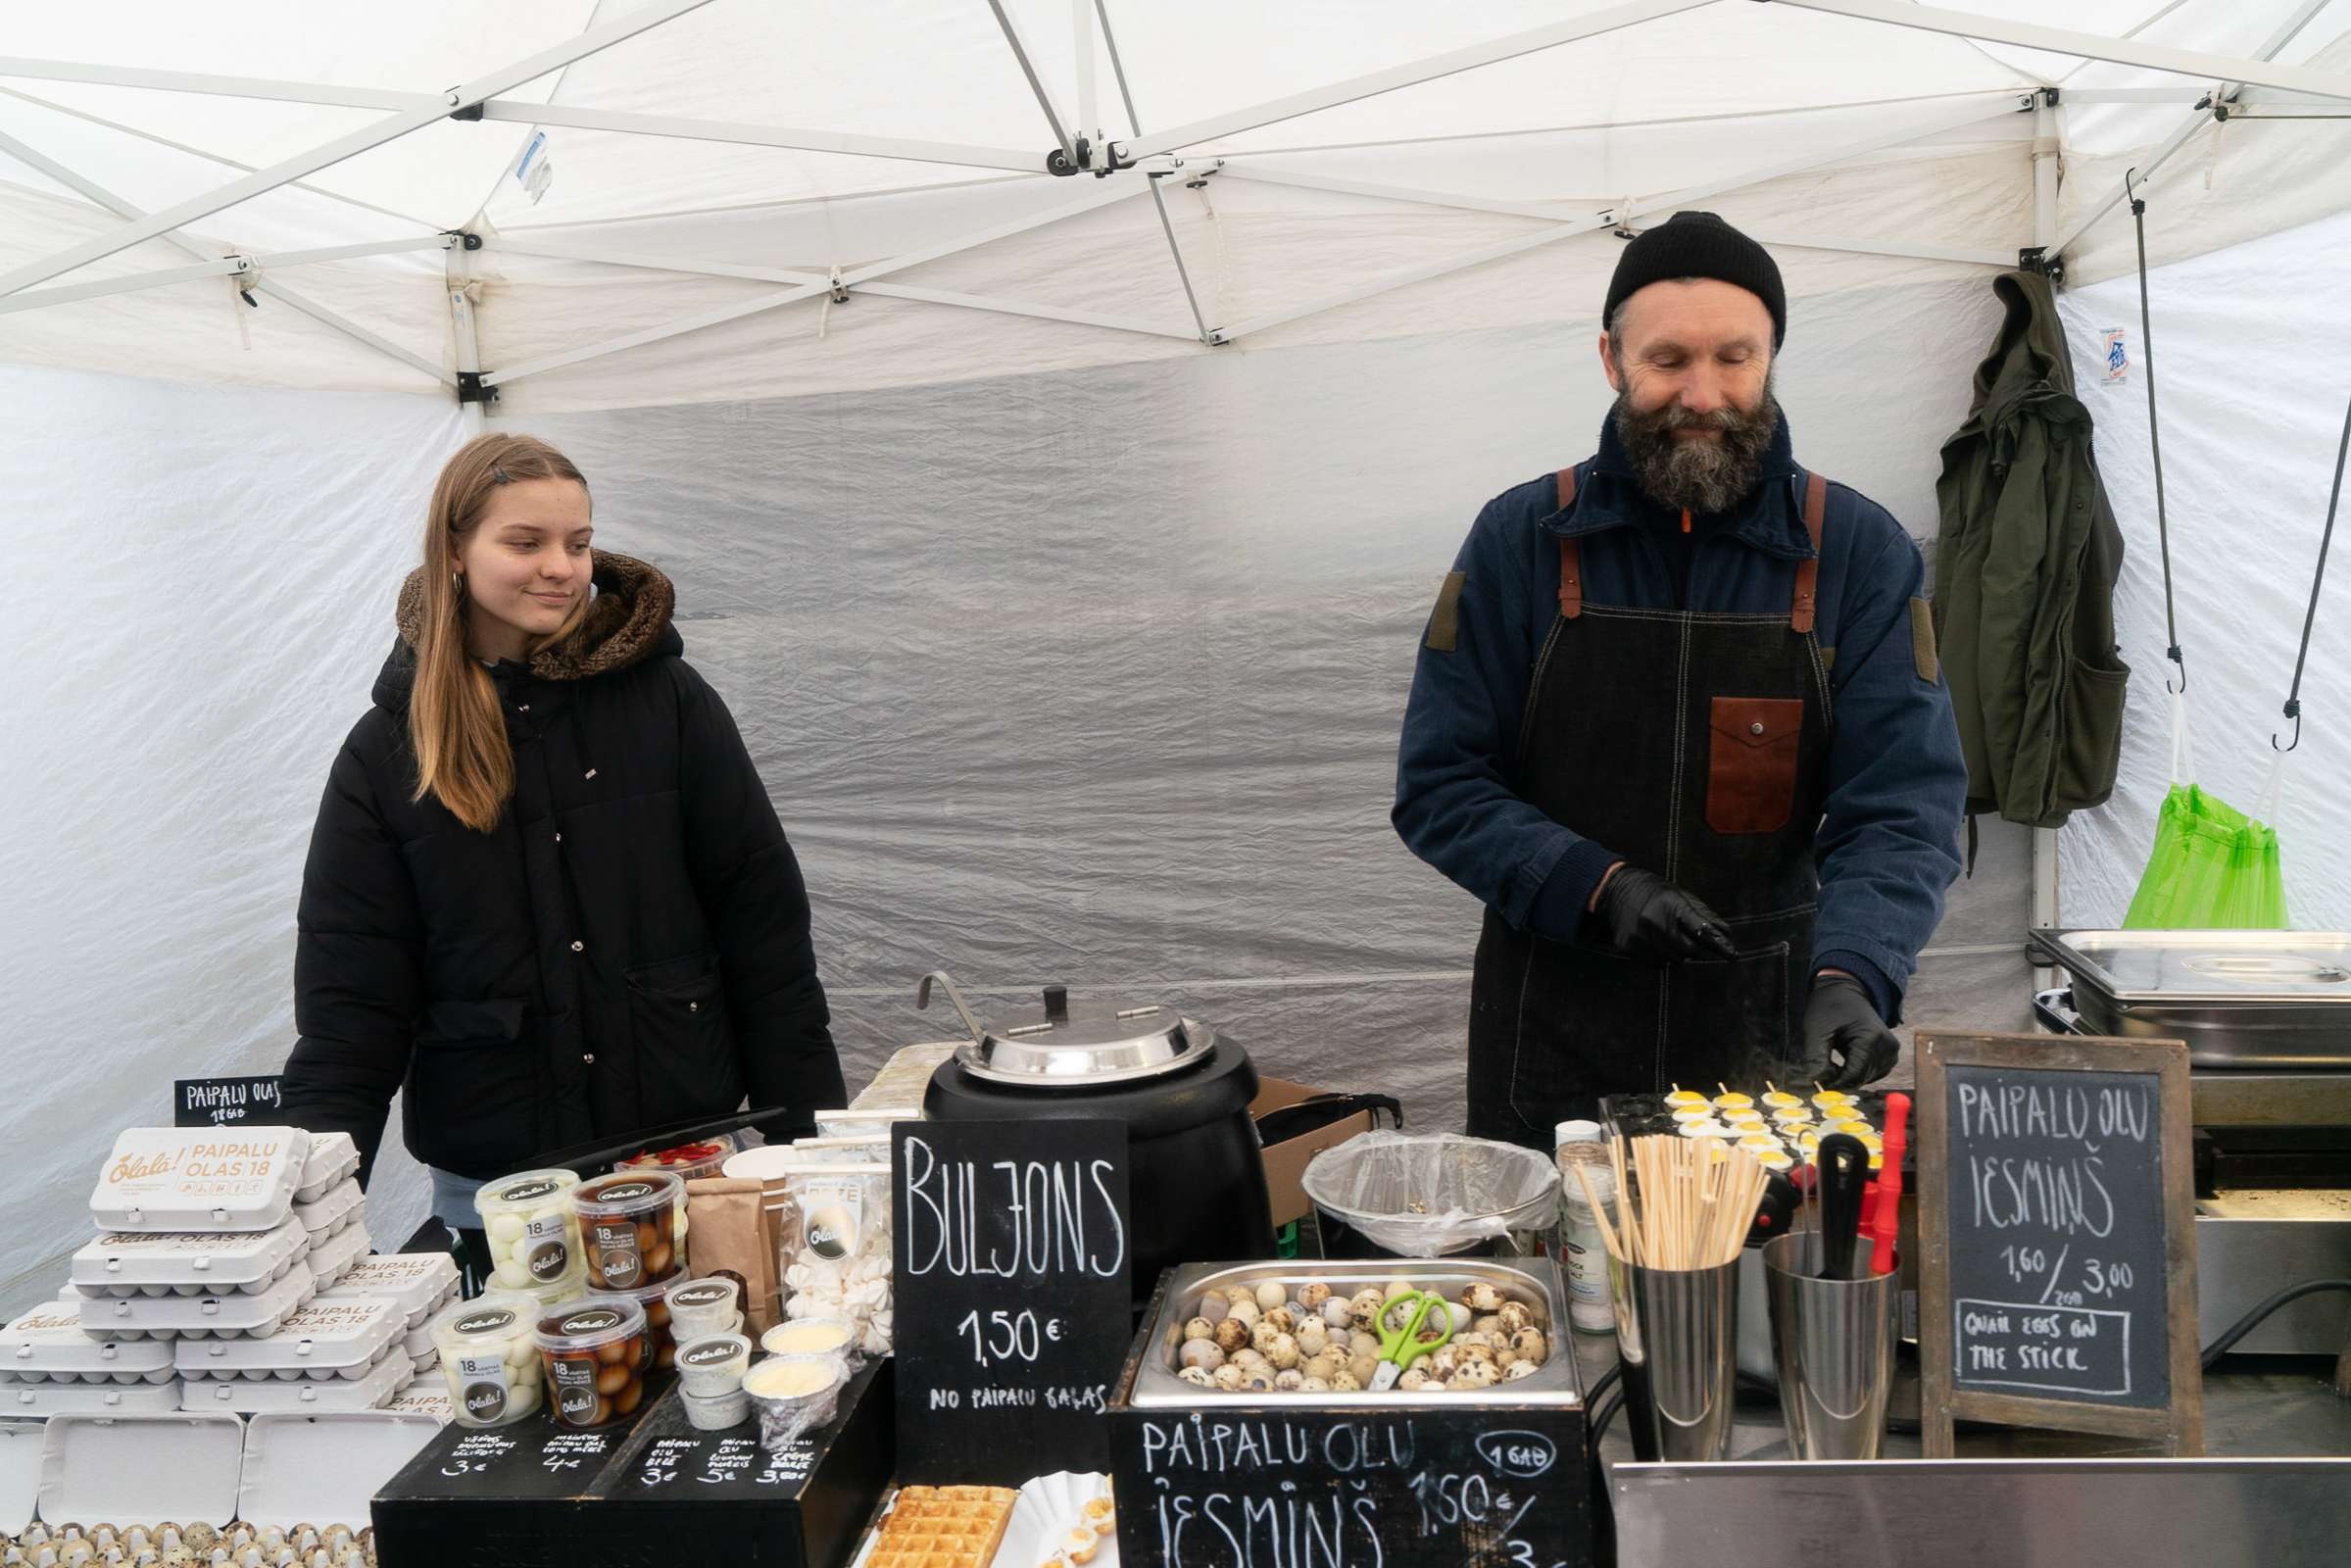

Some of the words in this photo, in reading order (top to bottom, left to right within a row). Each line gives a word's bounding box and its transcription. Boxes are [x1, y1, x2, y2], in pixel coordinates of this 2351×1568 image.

[187, 1081, 246, 1109] PAIPALU
[1959, 1078, 2089, 1140] PAIPALU
[2098, 1085, 2148, 1142] OLU
[191, 1143, 279, 1158] PAIPALU
[185, 1162, 243, 1177] OLAS
[249, 1160, 270, 1177] 18
[905, 1136, 1125, 1278] BULJONS
[527, 1222, 543, 1235] 18
[596, 1227, 612, 1240] 18
[350, 1258, 435, 1272] PAIPALU
[343, 1271, 400, 1281] OLAS
[406, 1267, 424, 1277] 18
[293, 1304, 381, 1316] PAIPALU
[284, 1317, 343, 1326] OLAS
[347, 1314, 370, 1324] 18
[1964, 1310, 2011, 1337] QUAIL
[2022, 1314, 2061, 1339] EGGS
[2070, 1313, 2098, 1338] ON
[957, 1309, 1062, 1368] 1,50€
[1969, 1344, 2008, 1371] THE
[2018, 1341, 2088, 1372] STICK
[461, 1359, 476, 1372] 18
[553, 1362, 568, 1376] 18
[391, 1396, 450, 1405] PAIPA
[930, 1388, 959, 1410] NO
[971, 1383, 1037, 1409] PAIPALU
[1143, 1414, 1308, 1473] PAIPALU
[1324, 1418, 1416, 1472] OLU
